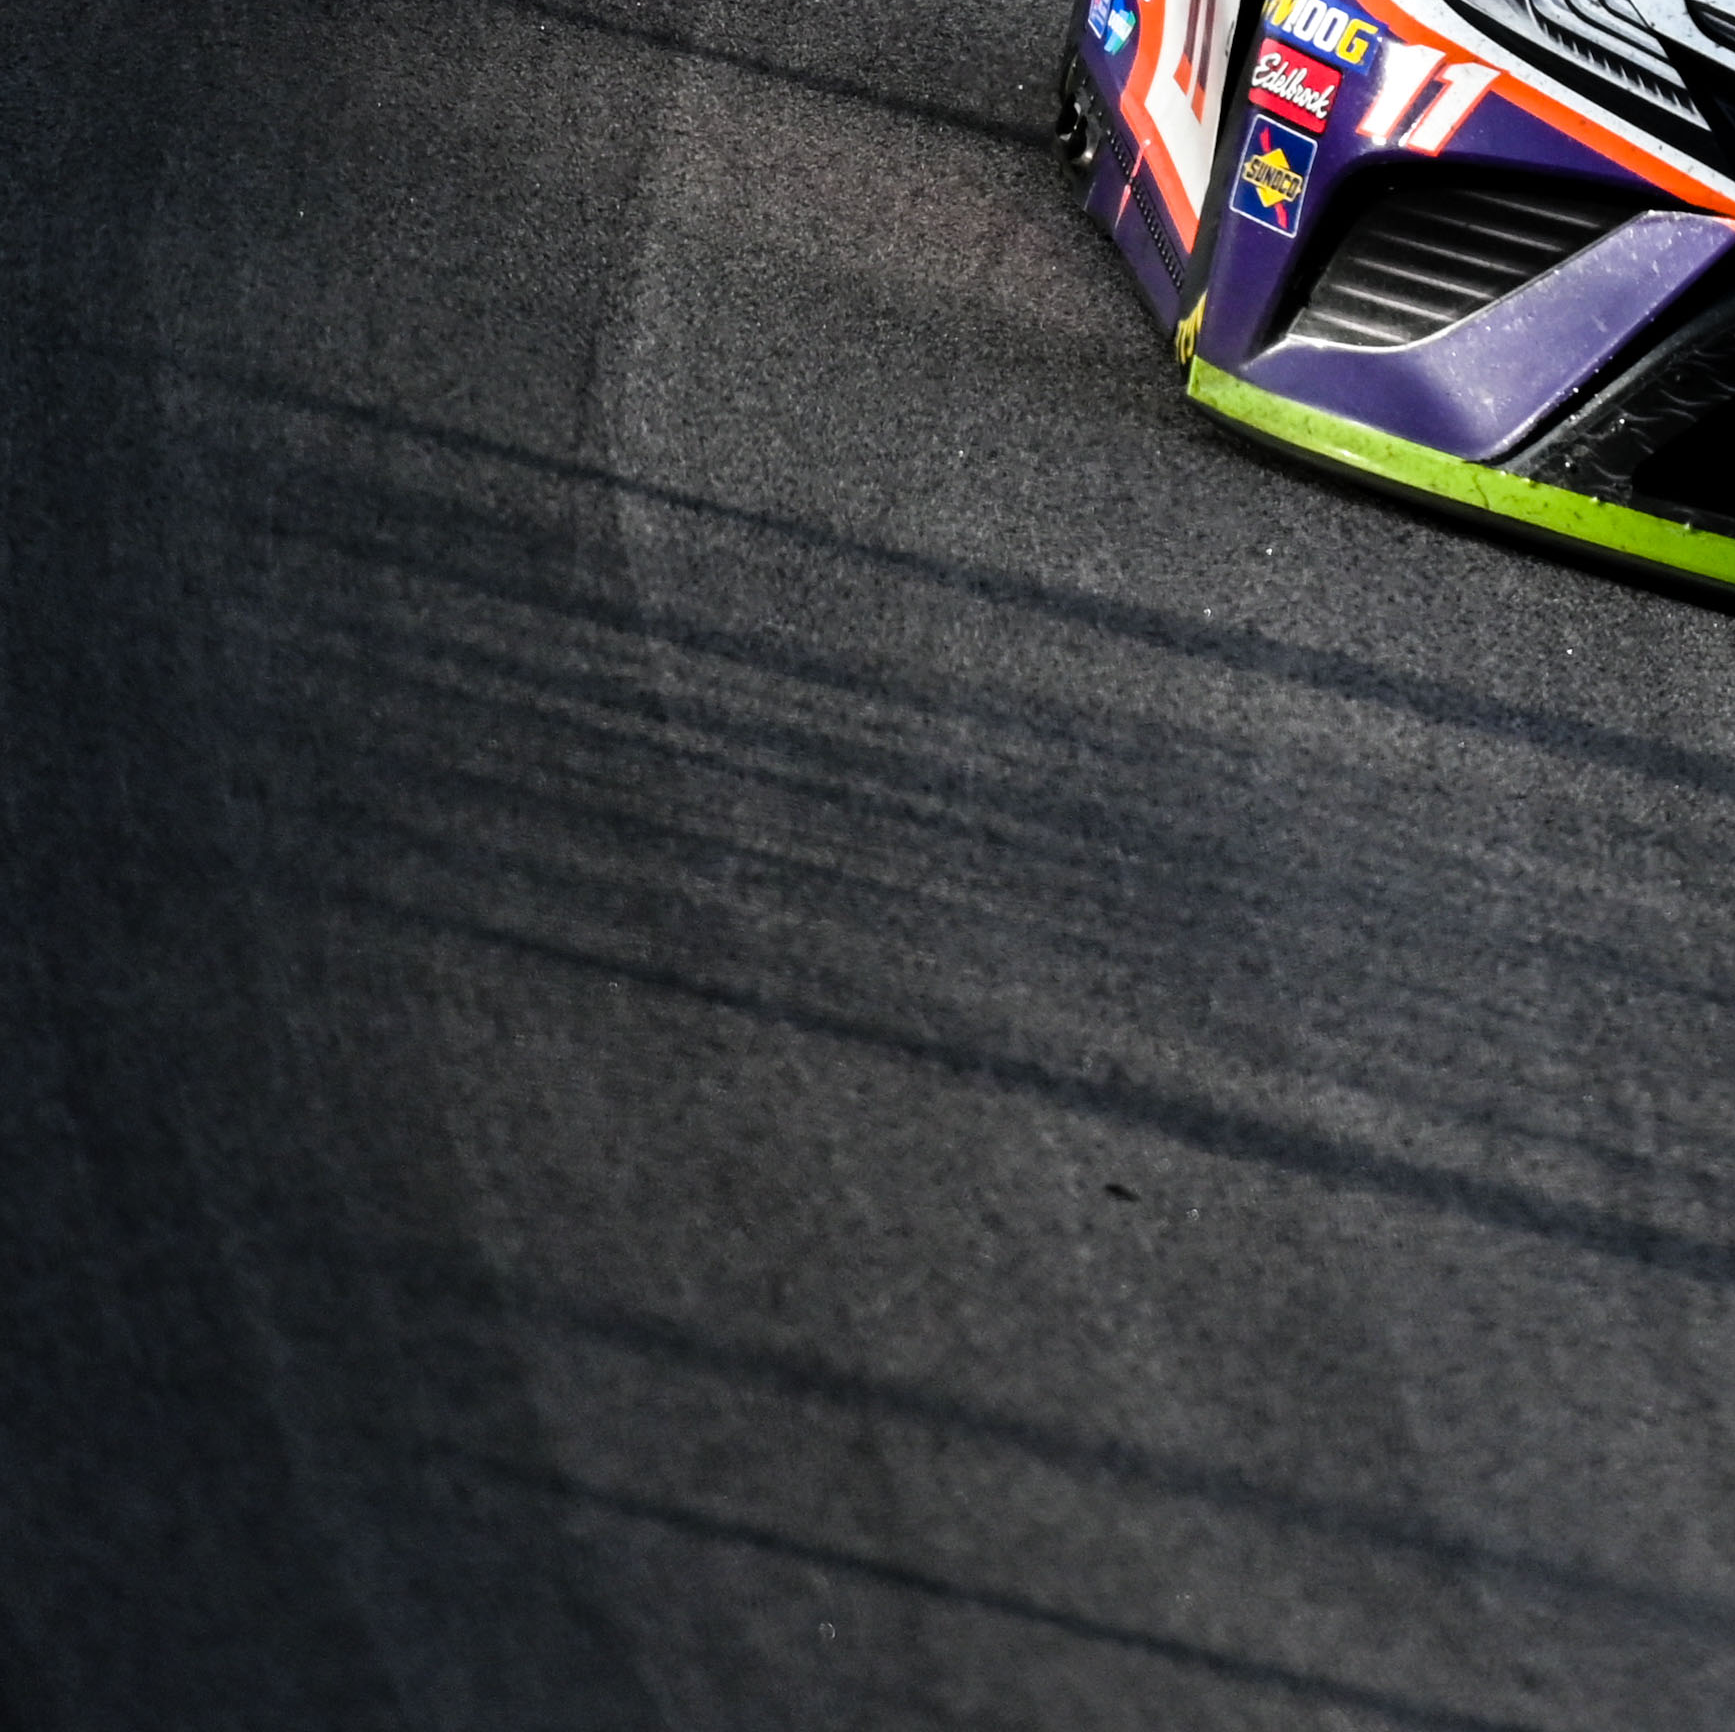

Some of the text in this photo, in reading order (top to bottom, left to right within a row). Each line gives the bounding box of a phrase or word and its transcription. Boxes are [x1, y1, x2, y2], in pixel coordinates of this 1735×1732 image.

[1251, 52, 1335, 118] Edelbrock
[1356, 40, 1501, 157] 11
[1246, 158, 1301, 196] SUNOCO
